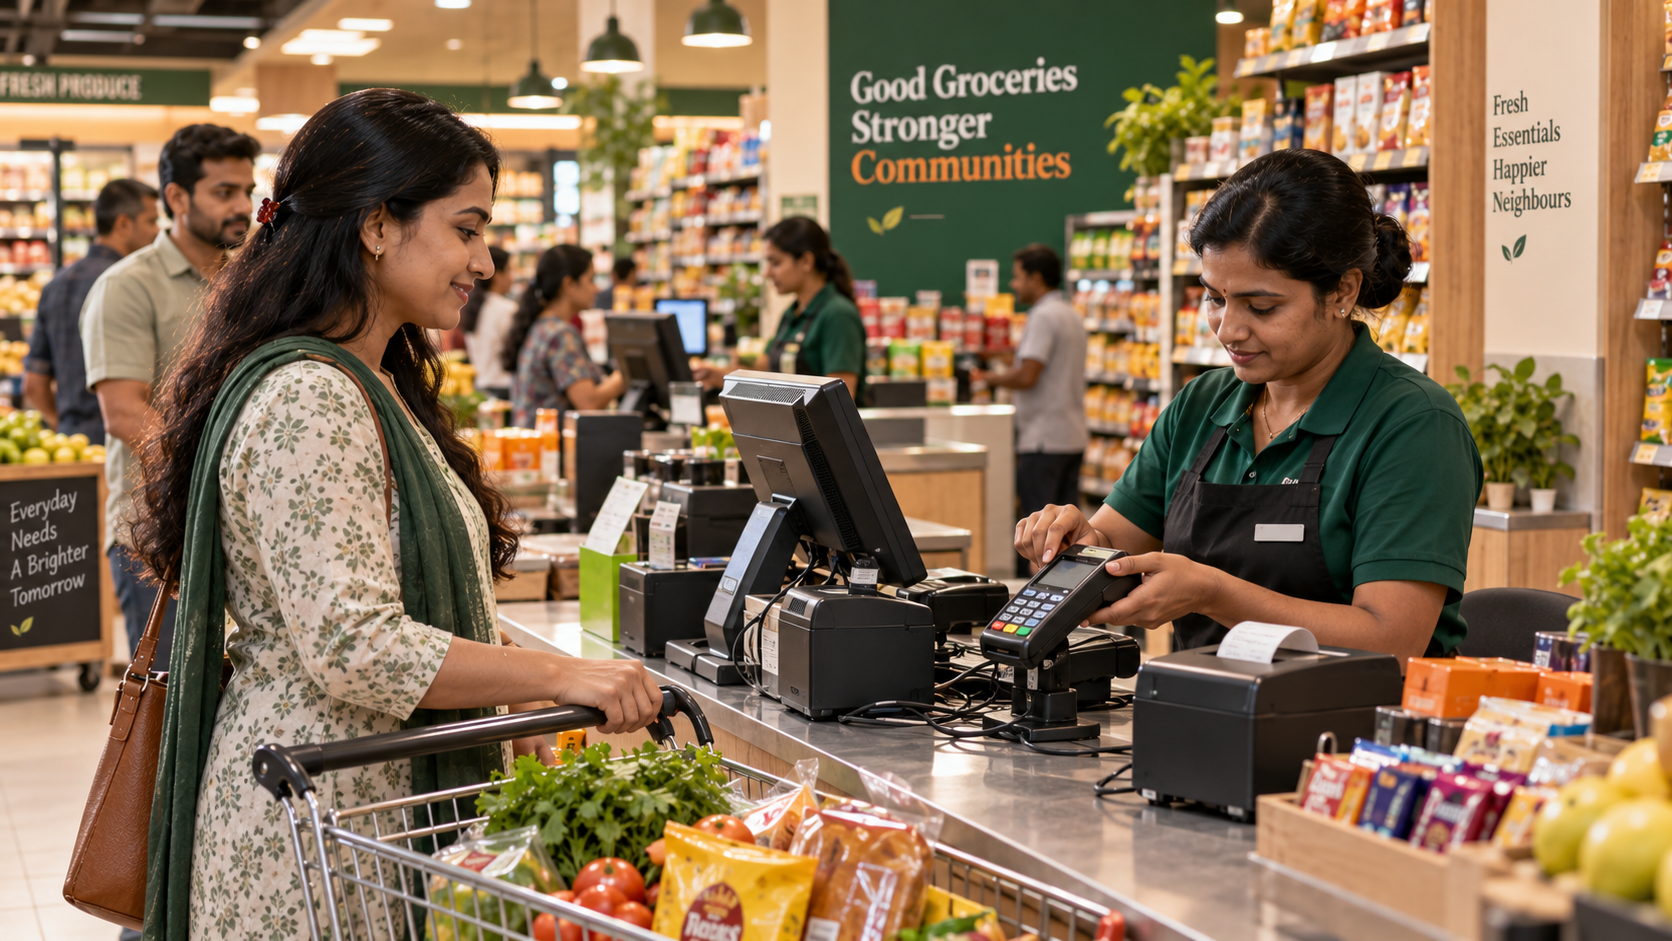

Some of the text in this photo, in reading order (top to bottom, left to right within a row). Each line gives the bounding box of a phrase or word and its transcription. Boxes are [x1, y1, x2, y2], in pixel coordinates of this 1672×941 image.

[0, 72, 142, 100] FRESH PRODUCE
[851, 56, 1078, 104] Good Groceries
[1493, 90, 1529, 116] Fresh
[852, 109, 992, 150] Stronger
[1493, 119, 1561, 148] Essentials
[851, 142, 1072, 185] Communities
[1493, 155, 1547, 185] Happier
[1492, 187, 1572, 218] Neighbours
[10, 488, 77, 523] Everyday
[11, 520, 58, 551] Needs
[10, 544, 89, 580] A Brighter
[10, 573, 86, 607] Tomorrow
